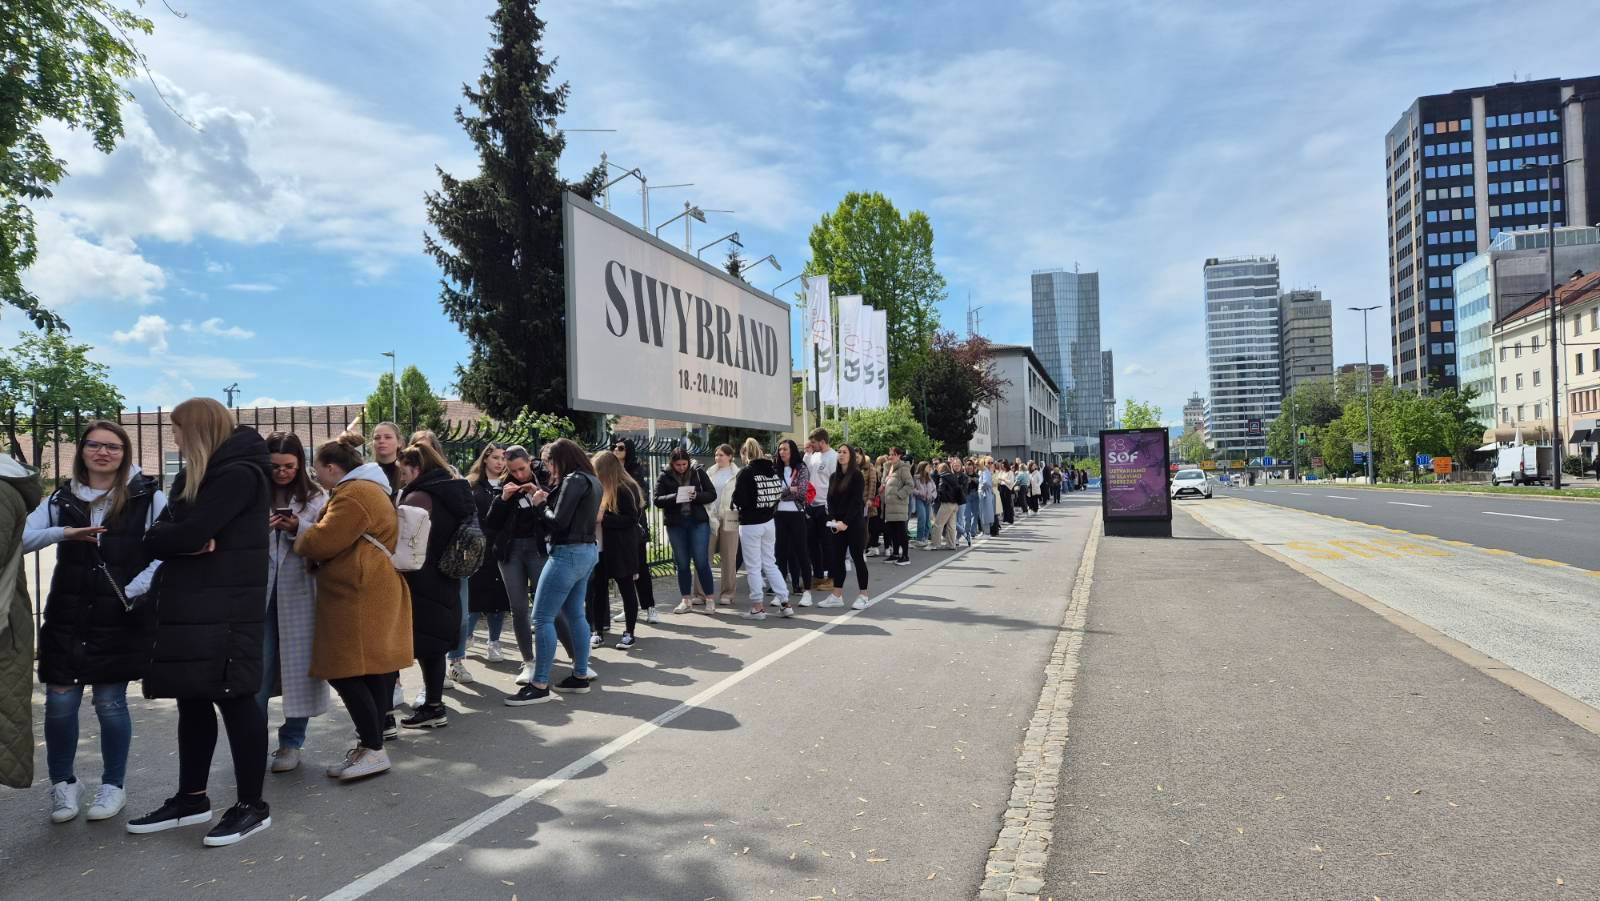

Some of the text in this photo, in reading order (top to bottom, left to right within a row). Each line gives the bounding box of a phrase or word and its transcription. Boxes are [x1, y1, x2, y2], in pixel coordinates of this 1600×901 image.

[605, 260, 779, 377] SWYBRAND
[678, 368, 738, 399] 18.-20.4.2024
[1108, 451, 1138, 463] SOF
